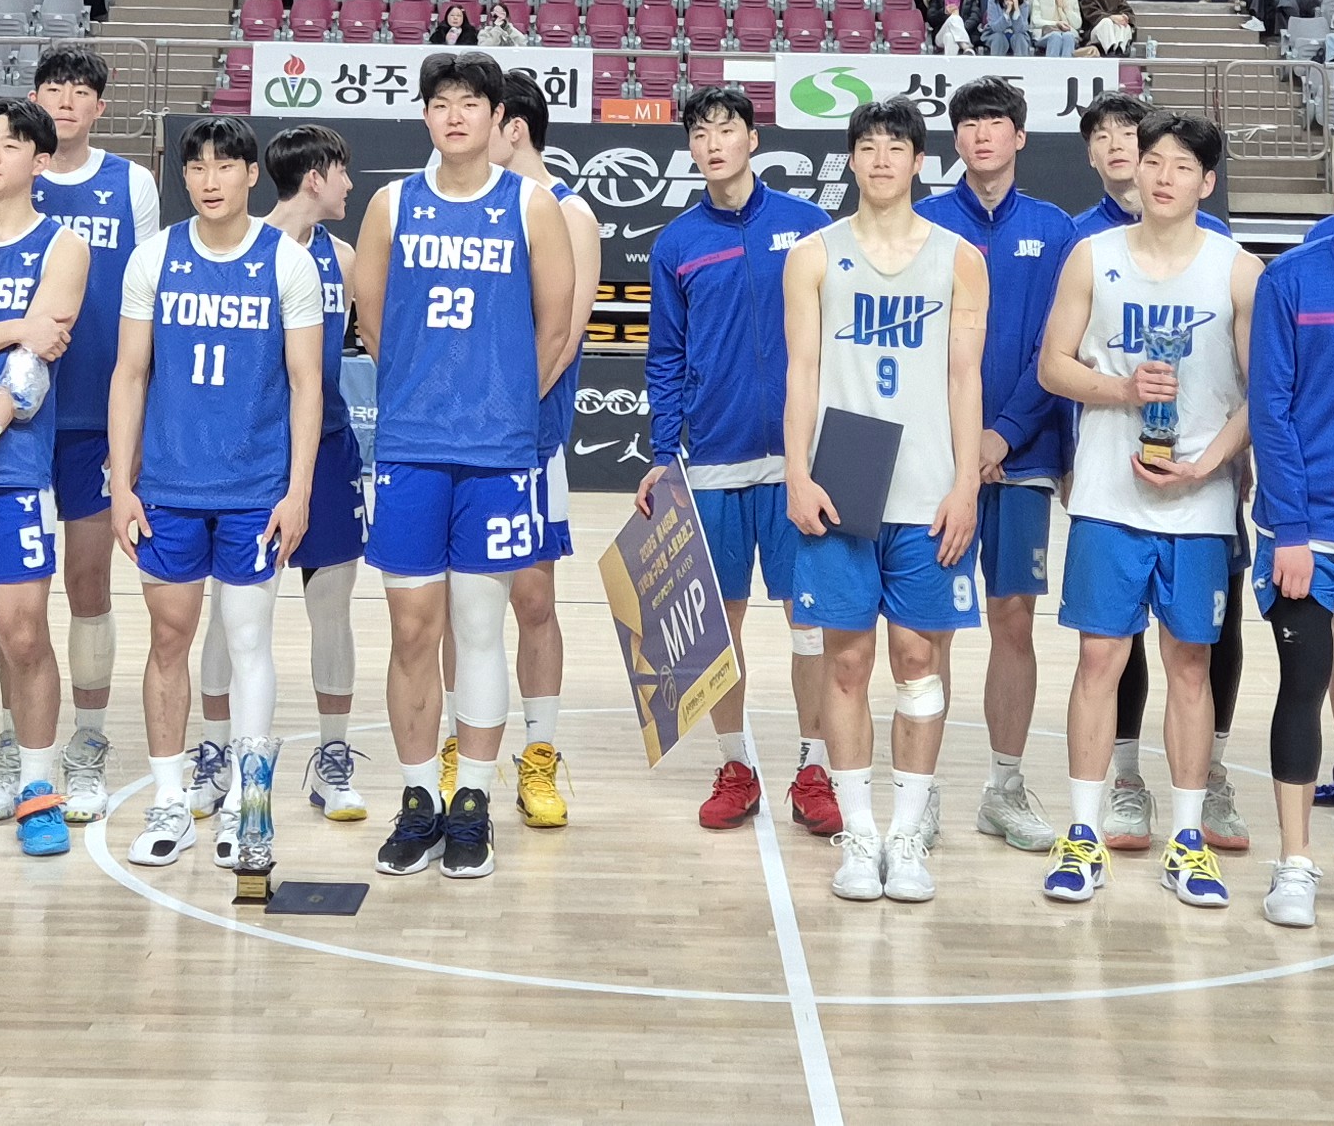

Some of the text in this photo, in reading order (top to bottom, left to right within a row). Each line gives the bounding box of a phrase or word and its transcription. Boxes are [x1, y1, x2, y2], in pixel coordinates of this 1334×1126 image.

[635, 103, 661, 120] M1
[399, 234, 515, 274] YONSEI
[160, 292, 270, 330] YONSEI
[427, 287, 475, 329] 23
[853, 292, 928, 349] DKU
[192, 344, 225, 386] 11
[875, 356, 899, 399] 9
[20, 526, 46, 569] 5
[486, 517, 533, 560] 23
[953, 575, 973, 612] 9
[660, 578, 707, 668] MVP
